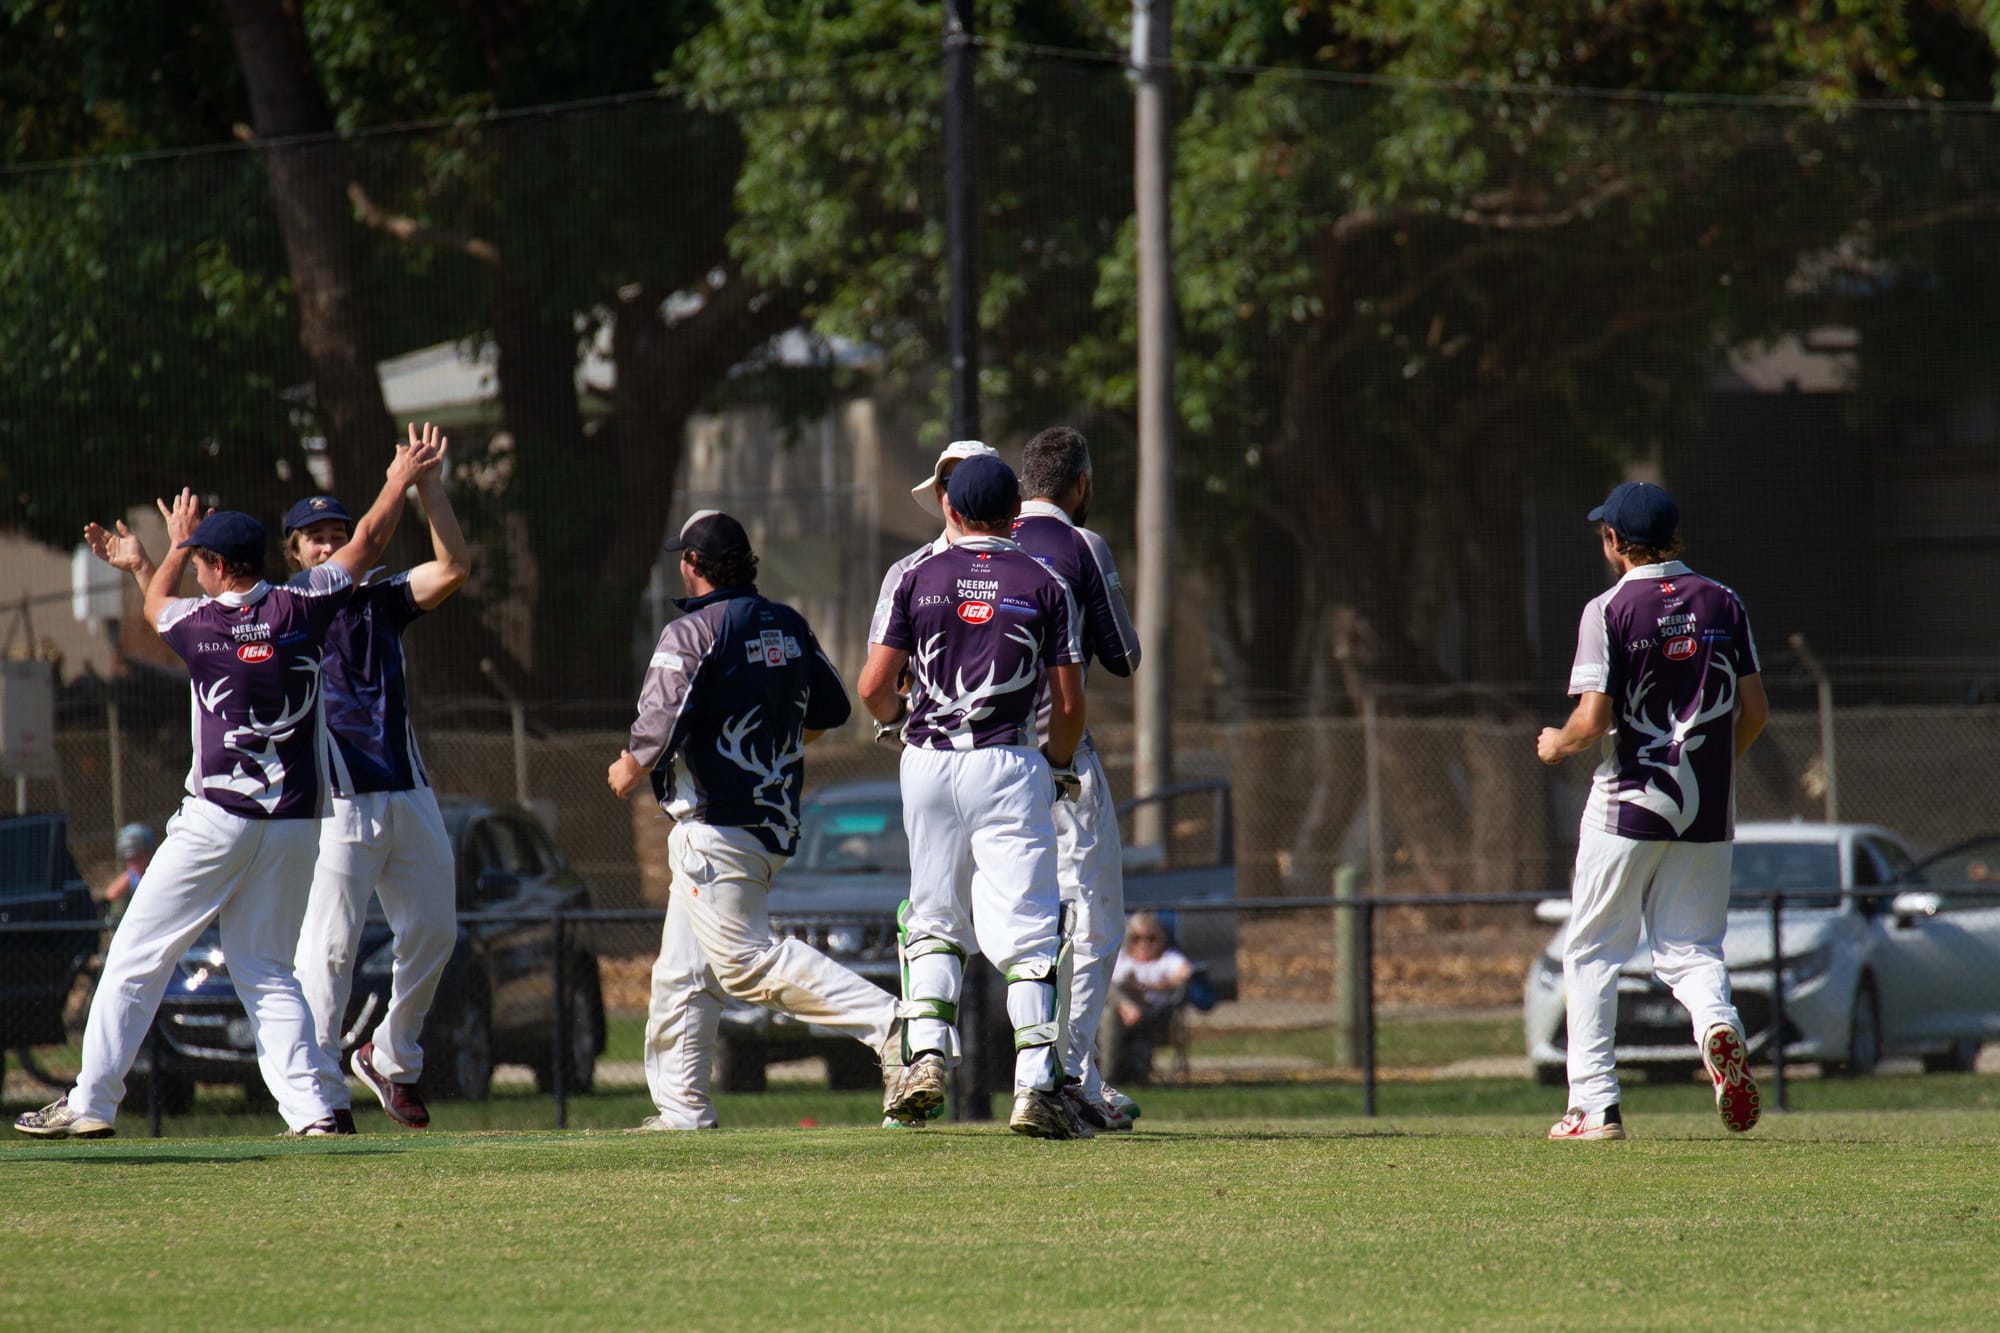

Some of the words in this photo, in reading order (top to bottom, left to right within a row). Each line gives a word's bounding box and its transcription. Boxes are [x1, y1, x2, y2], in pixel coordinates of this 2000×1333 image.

[957, 579, 998, 590] NEERIM
[958, 589, 996, 600] SOUTH
[962, 605, 989, 618] IGA
[1657, 612, 1697, 627] NEERIM
[234, 630, 271, 643] SOUTH
[1661, 623, 1696, 637] SOUTH
[243, 646, 269, 659] IGA
[1667, 640, 1692, 656] IGA
